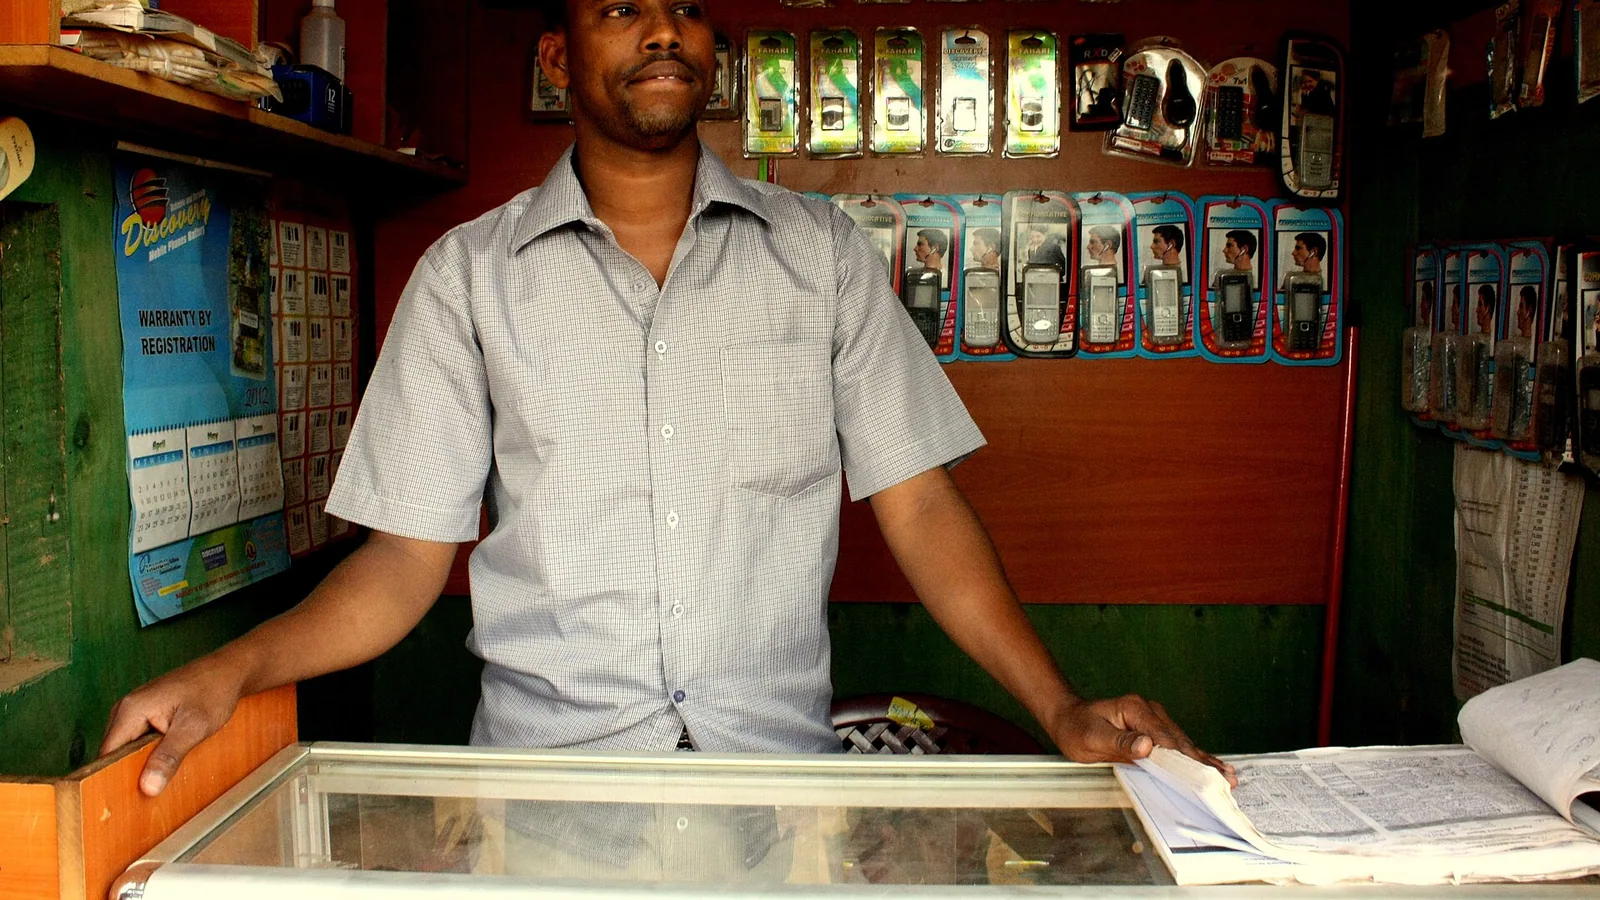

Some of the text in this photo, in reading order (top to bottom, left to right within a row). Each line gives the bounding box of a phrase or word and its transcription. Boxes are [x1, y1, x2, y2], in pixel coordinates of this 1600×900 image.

[328, 88, 336, 103] 12
[121, 195, 211, 257] Discovery
[148, 244, 167, 262] Mobile
[139, 310, 212, 328] WARRANTY BY
[141, 336, 216, 356] REGISTRATION
[207, 432, 218, 441] May
